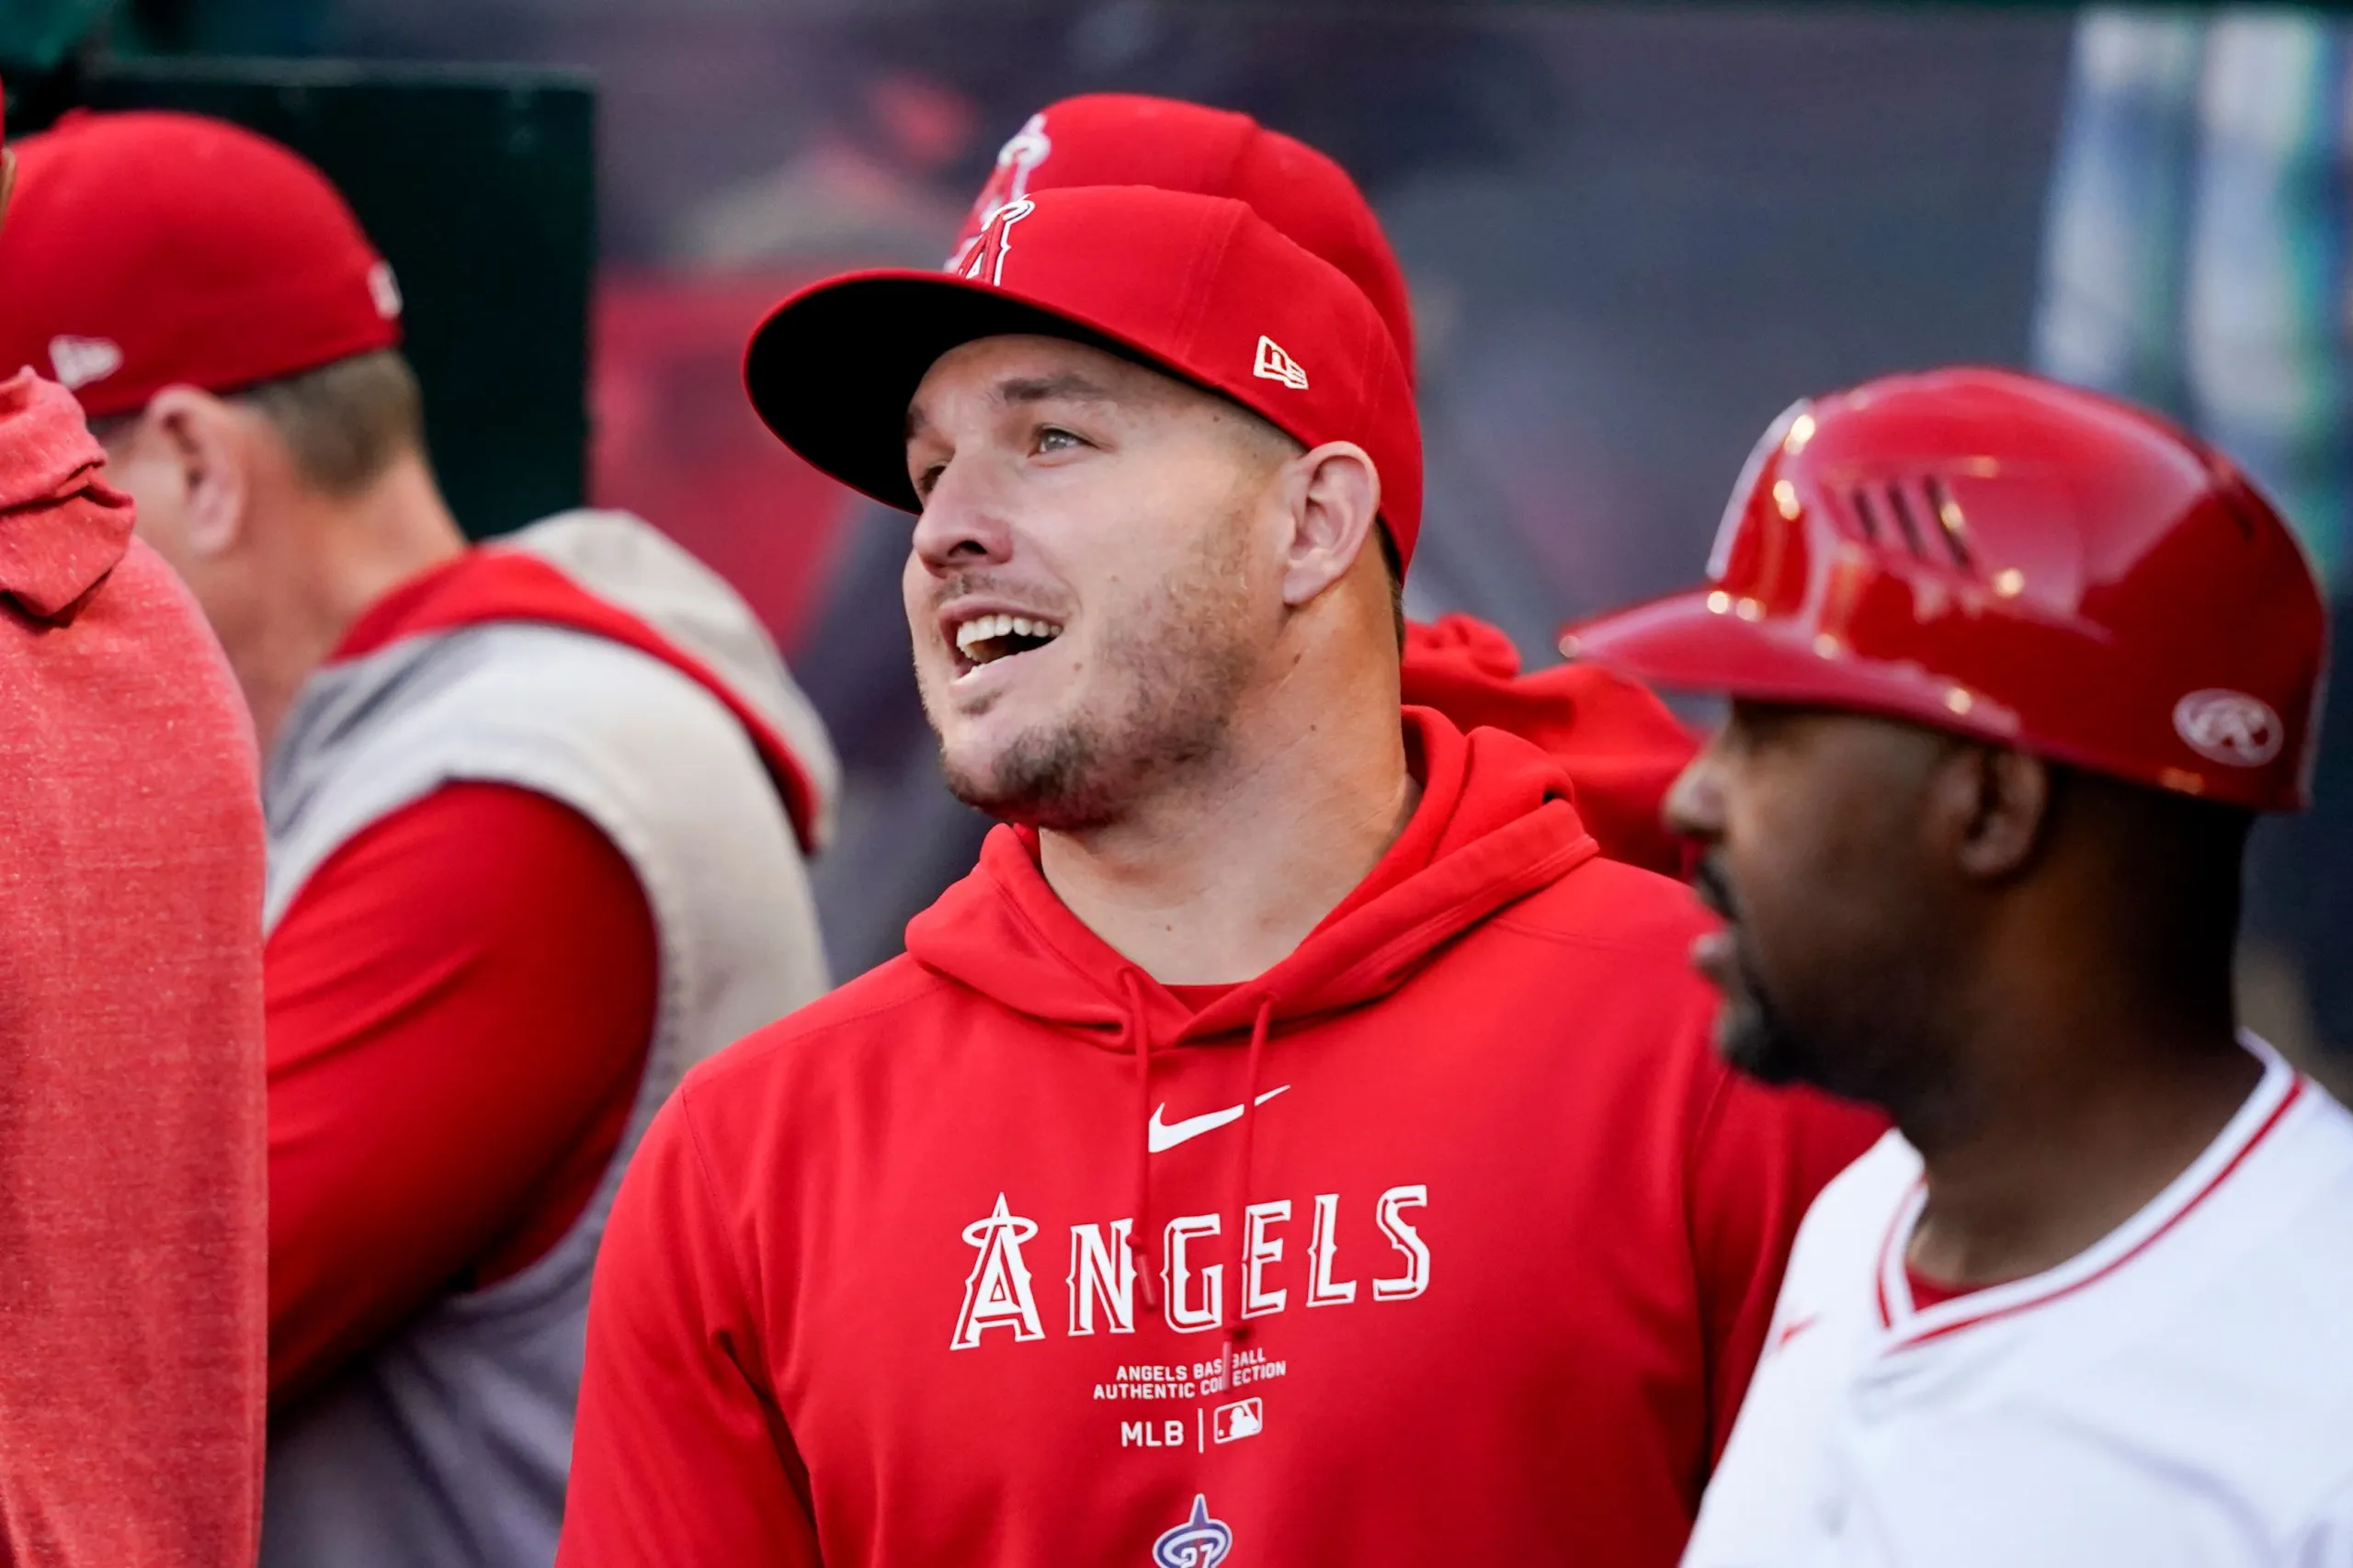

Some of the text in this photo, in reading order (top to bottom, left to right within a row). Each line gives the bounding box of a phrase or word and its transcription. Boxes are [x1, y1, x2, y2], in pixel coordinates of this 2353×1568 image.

[949, 1184, 1430, 1351] ANGELS
[1116, 1347, 1267, 1382] ANGELS BASBALL
[1093, 1382, 1196, 1400] AUTHENTIC
[1120, 1420, 1185, 1448] MLB
